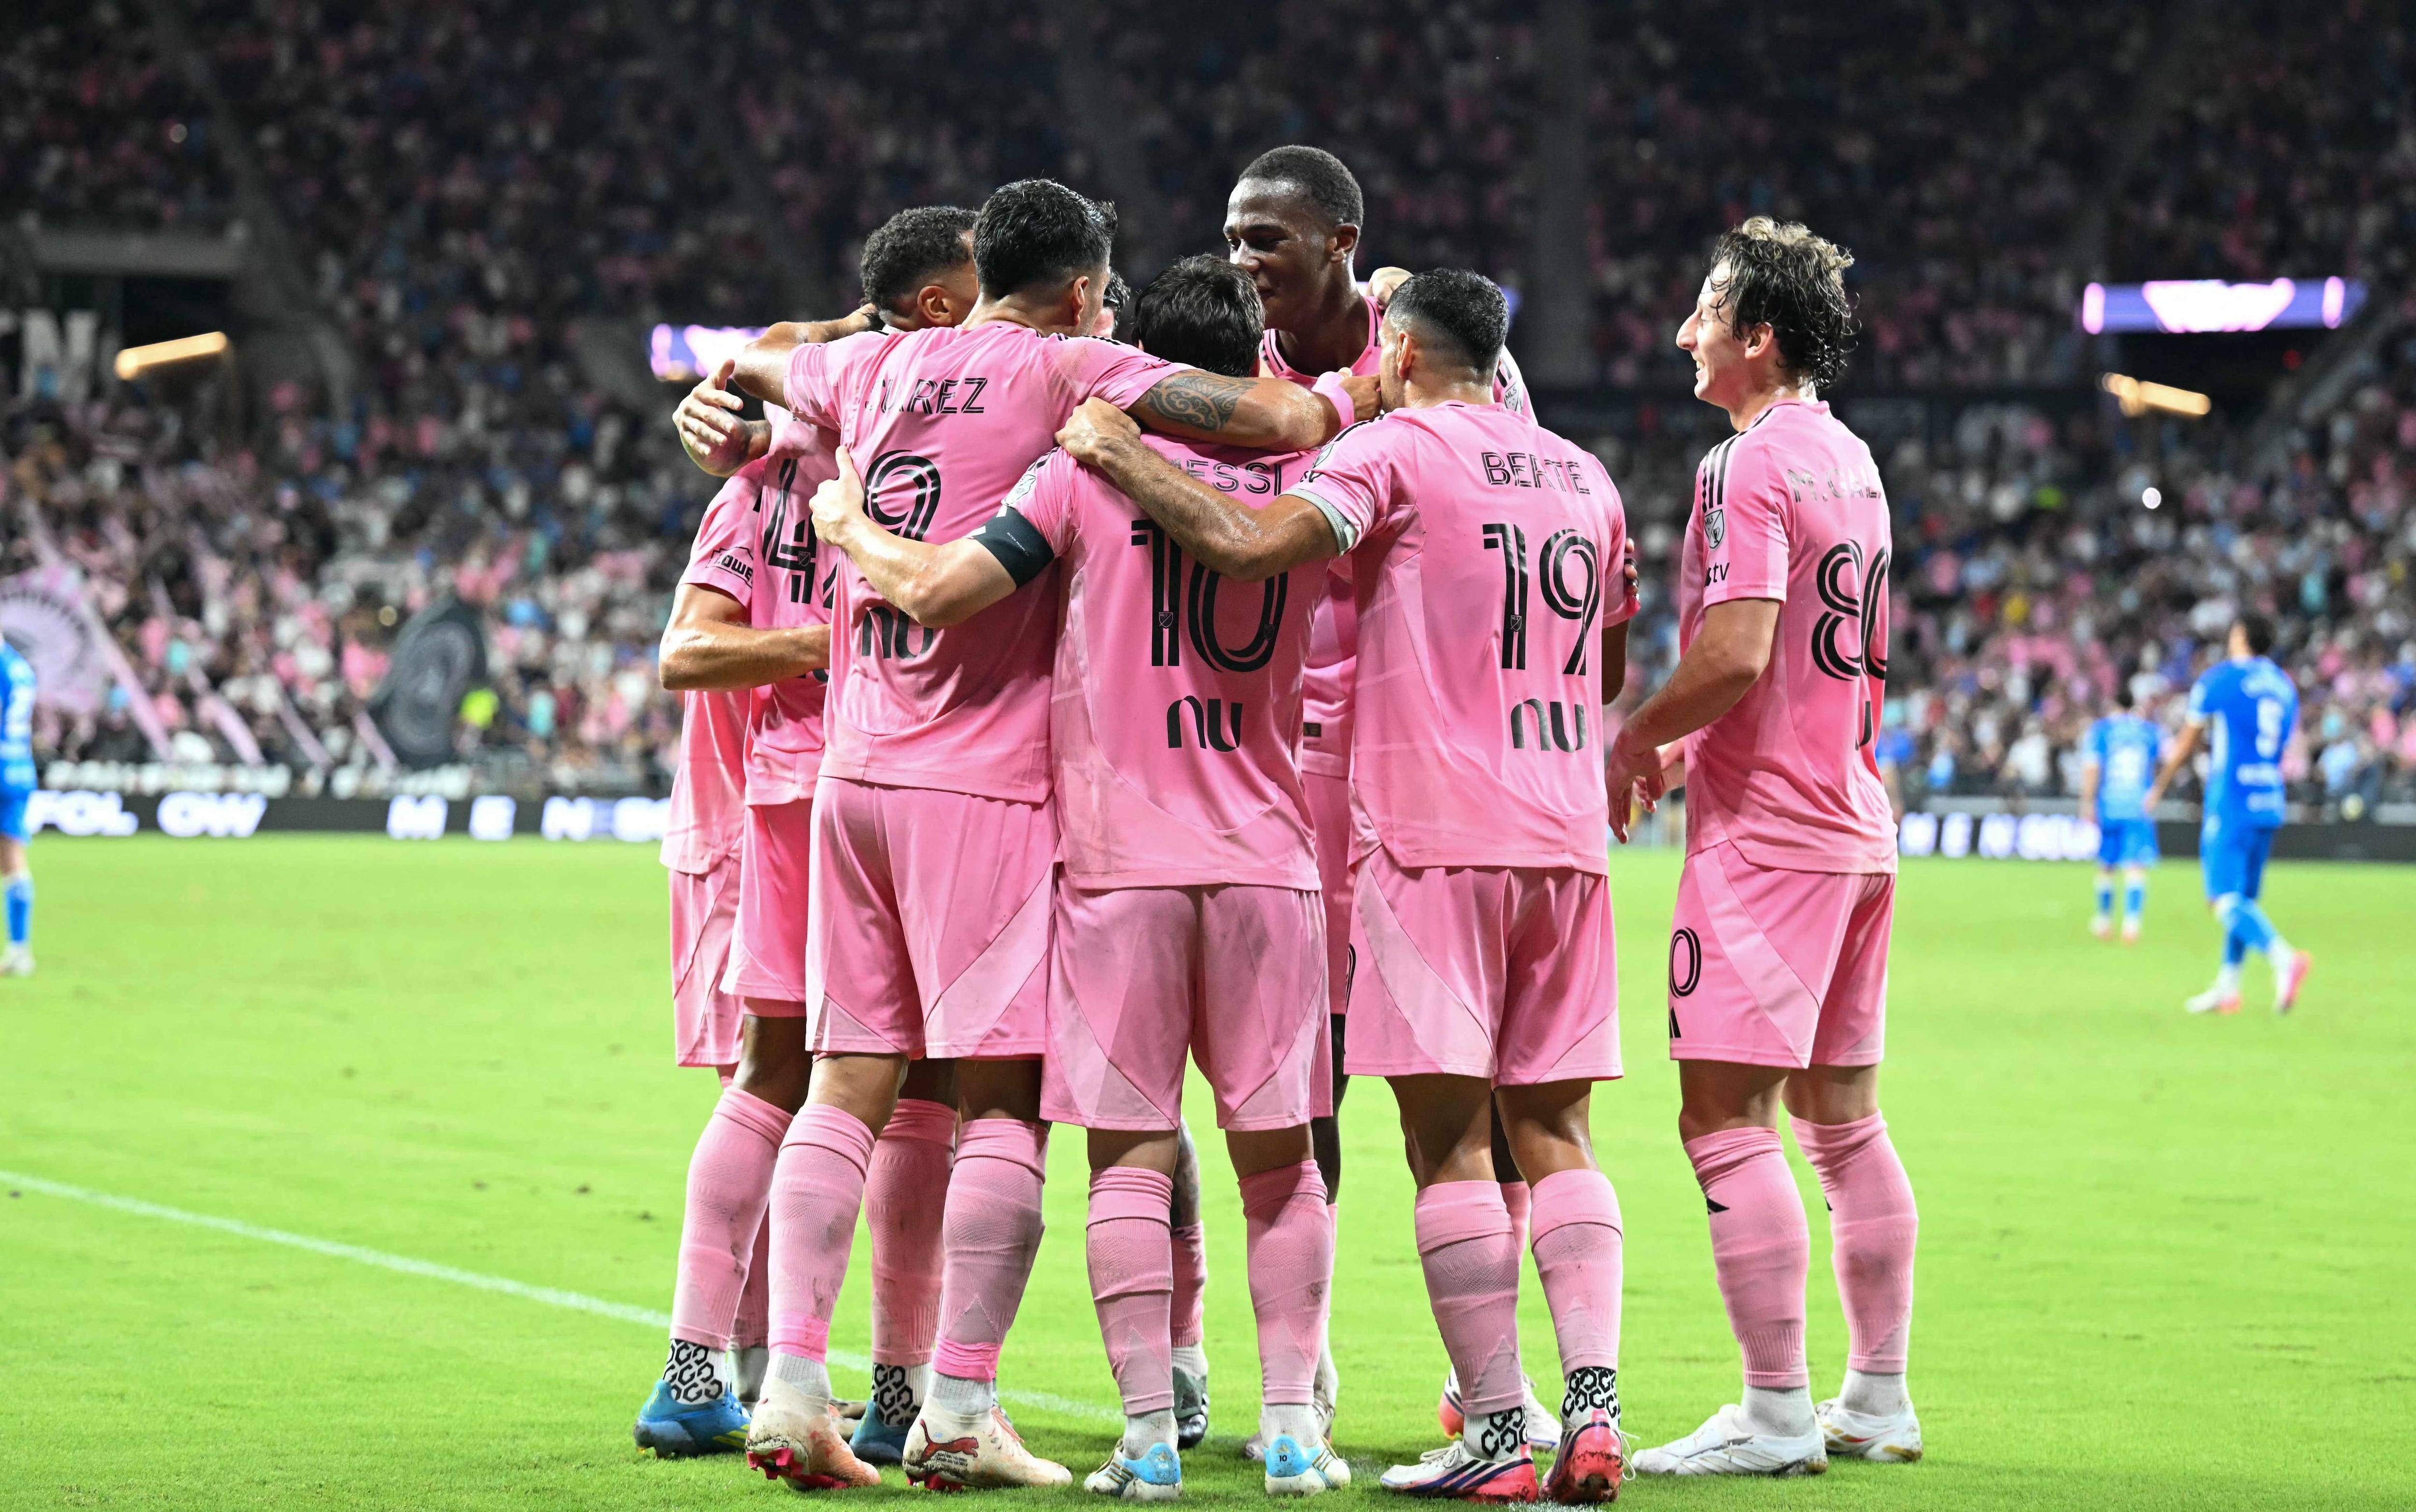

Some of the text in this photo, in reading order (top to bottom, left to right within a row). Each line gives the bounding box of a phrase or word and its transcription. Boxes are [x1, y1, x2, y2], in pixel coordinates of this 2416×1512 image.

[1505, 387, 1517, 401] MLS
[1170, 458, 1282, 496] ESSI
[1704, 515, 1714, 526] MLS
[1131, 518, 1289, 673] 10
[1482, 523, 1600, 676] 19
[1812, 538, 1889, 682] 80
